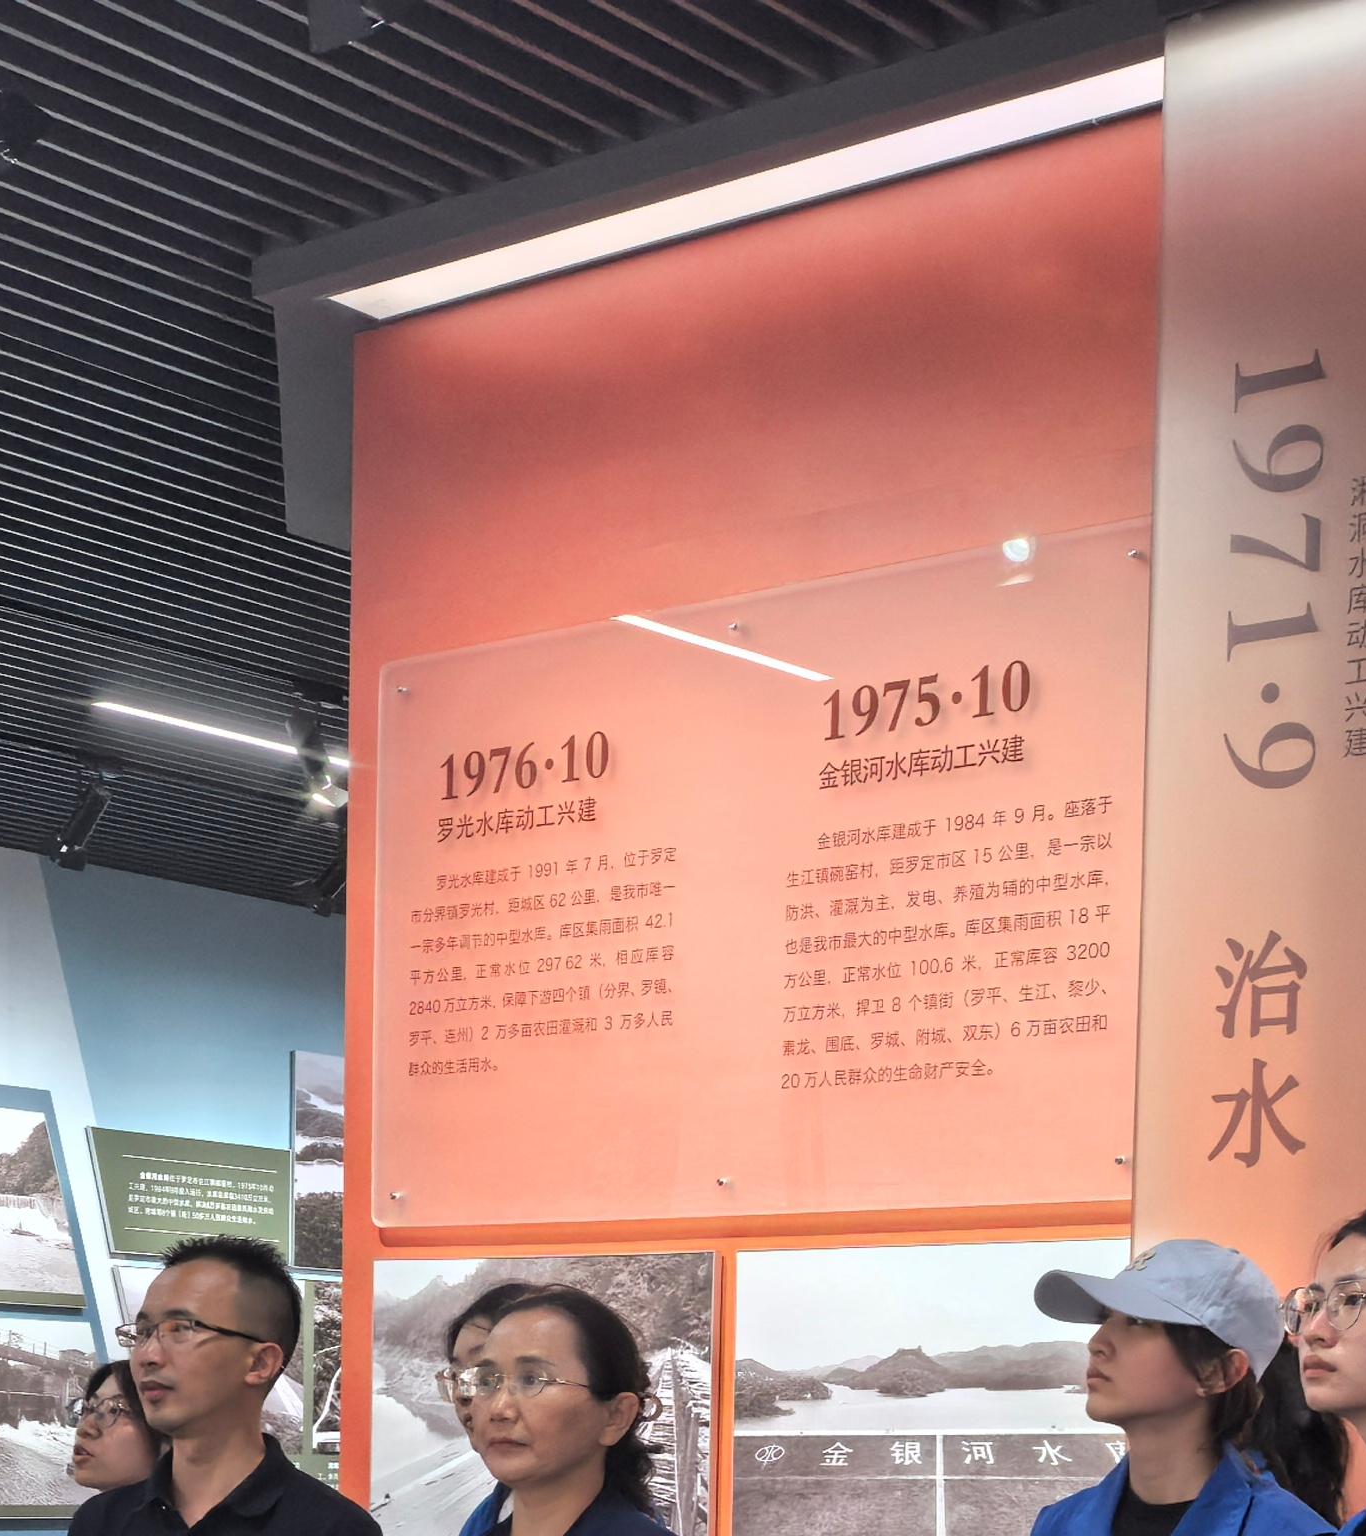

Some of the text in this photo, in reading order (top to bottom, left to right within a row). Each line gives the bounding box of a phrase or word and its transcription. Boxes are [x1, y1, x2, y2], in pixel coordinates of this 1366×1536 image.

[824, 660, 1030, 741] 1975·10
[441, 731, 609, 800] 1976·10
[819, 734, 1025, 790] 金银河水库动工兴建
[437, 796, 597, 843] 罗光水库动工兴建
[946, 813, 985, 832] 1984
[993, 810, 1006, 827] 年
[1014, 808, 1024, 824] 9
[974, 847, 992, 865] 15
[529, 861, 558, 877] 1991
[584, 858, 591, 870] 7
[550, 892, 566, 909] 62
[645, 912, 673, 929] 42.1
[1070, 908, 1088, 925] 18
[1095, 905, 1111, 923] 平
[1067, 941, 1110, 961] 3200
[410, 1000, 440, 1015] 2840
[892, 997, 900, 1012] 8
[481, 1026, 489, 1041] 2
[604, 1015, 612, 1030] 3
[1011, 1021, 1020, 1037] 6
[1206, 930, 1307, 1169] 治水
[781, 1073, 800, 1090] 20
